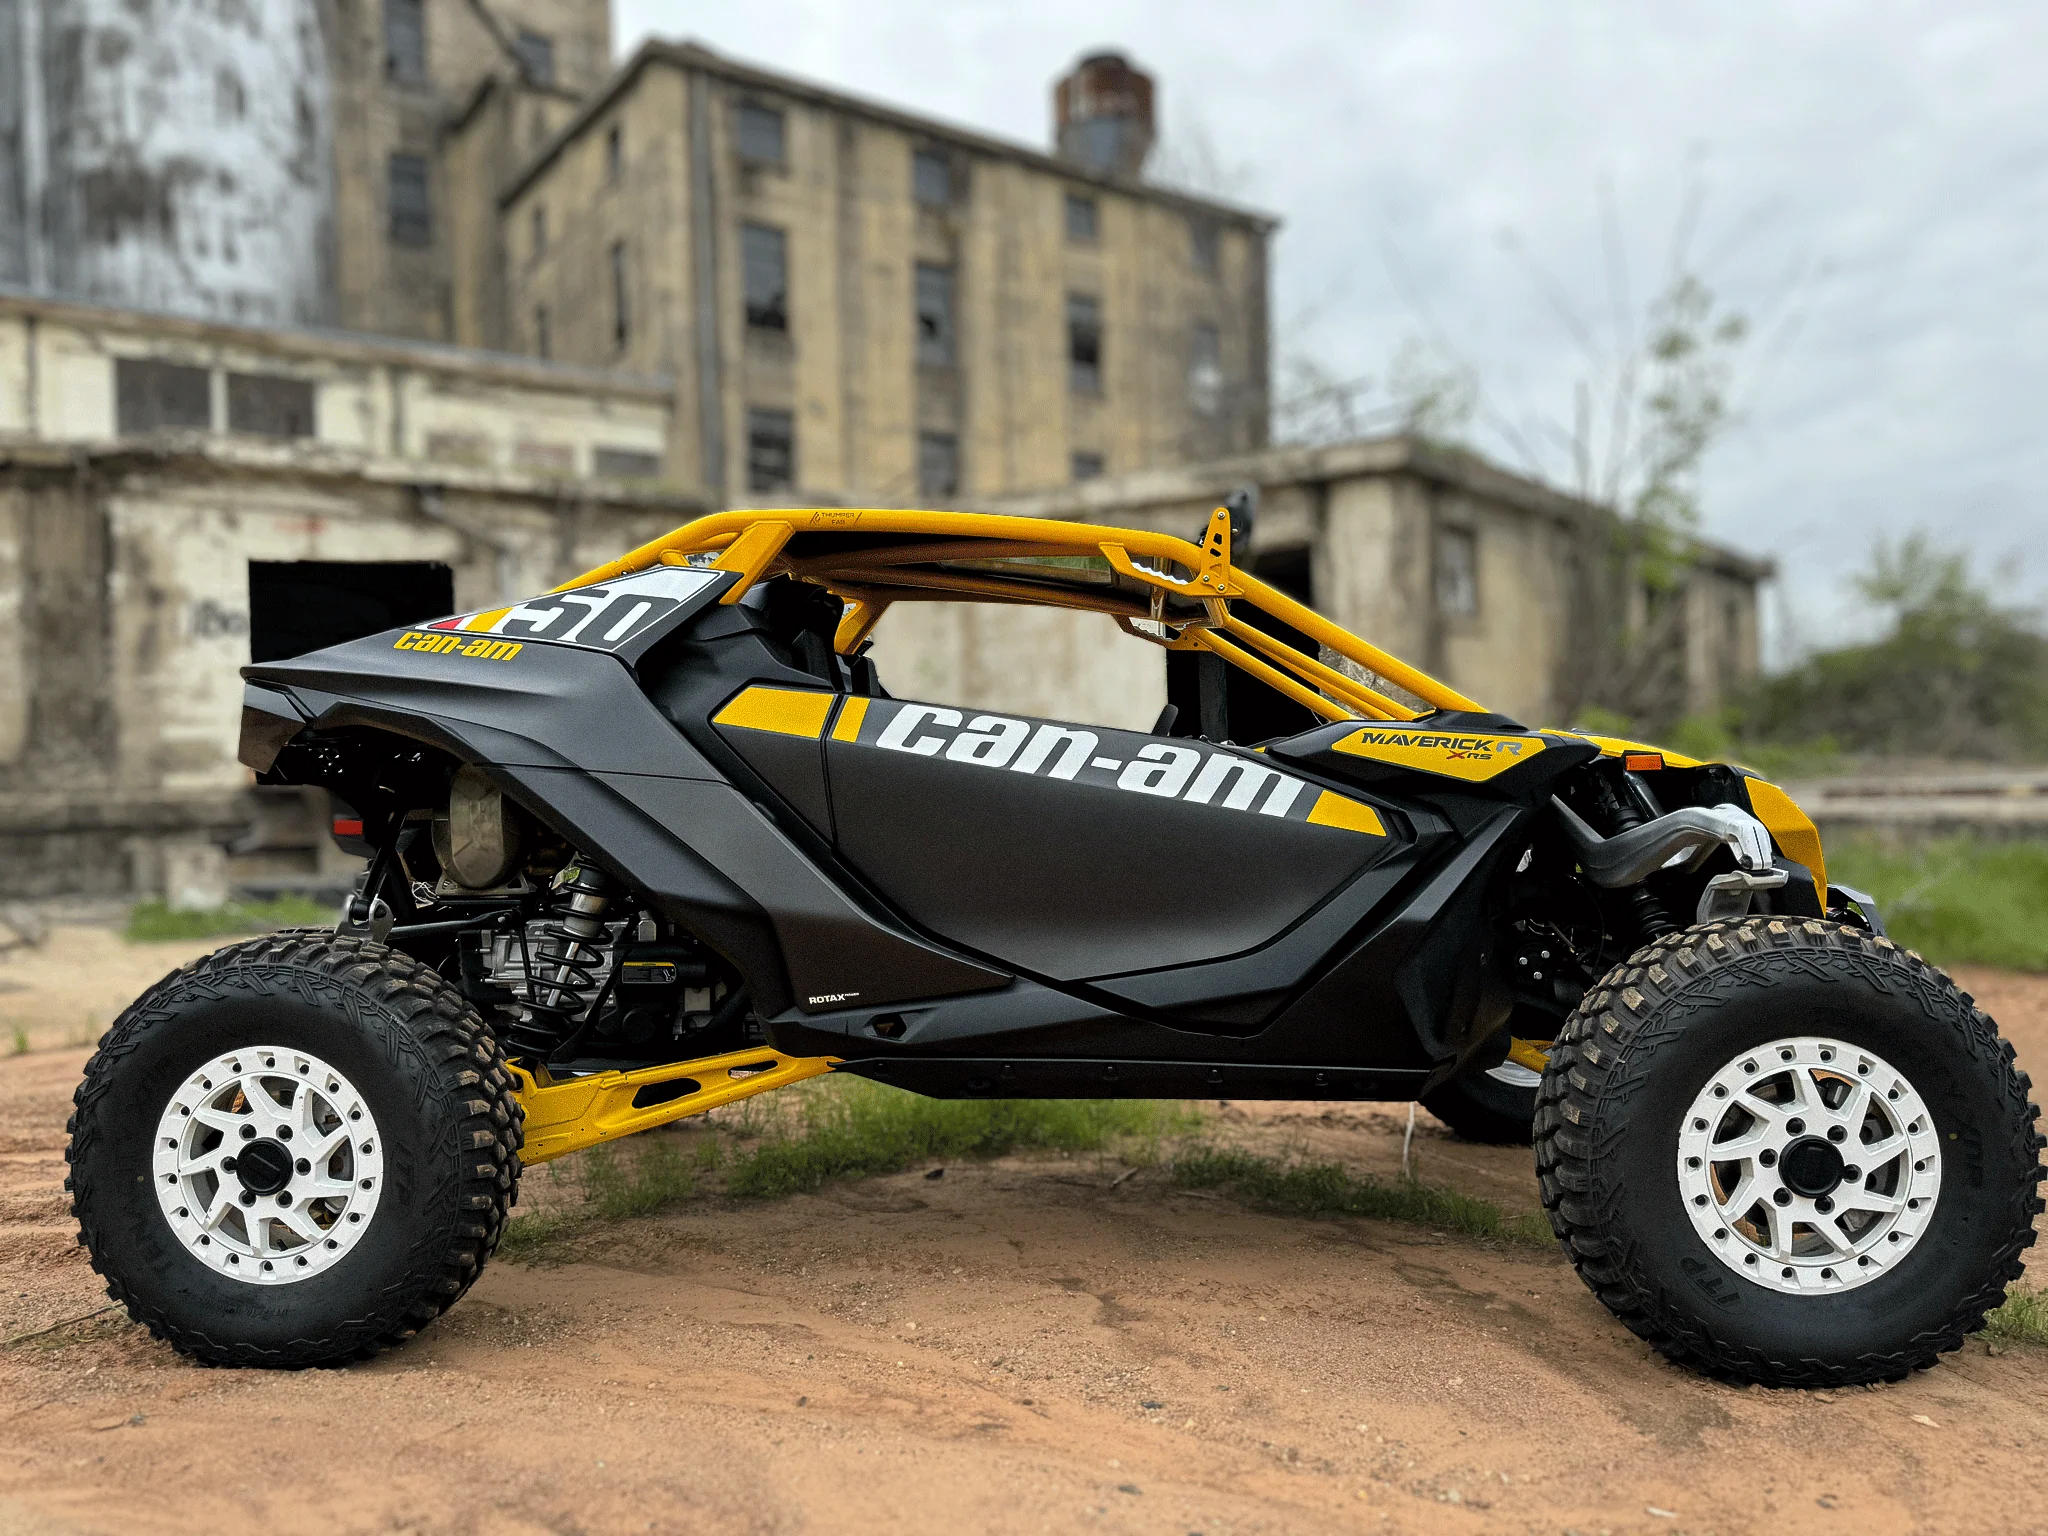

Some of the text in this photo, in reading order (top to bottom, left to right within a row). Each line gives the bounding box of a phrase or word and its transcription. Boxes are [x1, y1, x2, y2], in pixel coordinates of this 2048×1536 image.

[393, 631, 524, 661] can-am
[1361, 732, 1523, 756] MAVERICK R
[875, 703, 1307, 819] can-am
[809, 993, 846, 1004] ROTAX
